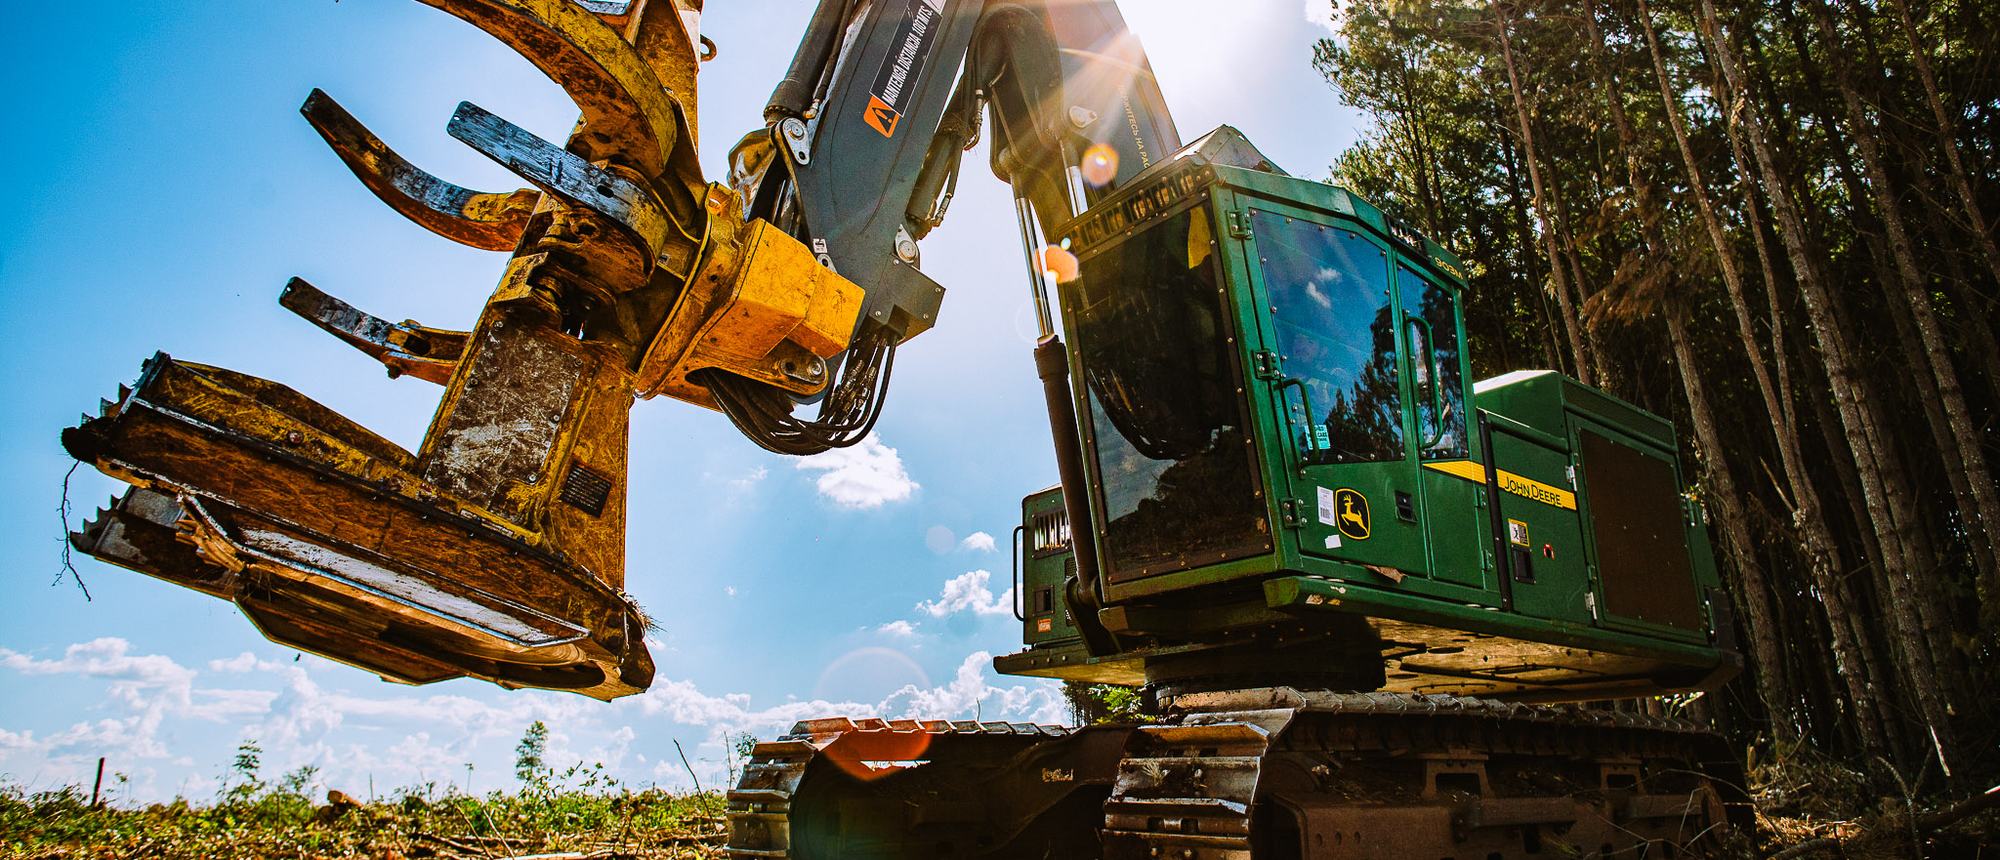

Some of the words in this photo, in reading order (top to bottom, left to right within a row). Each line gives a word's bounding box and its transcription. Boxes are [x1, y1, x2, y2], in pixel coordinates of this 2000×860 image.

[881, 65, 909, 107] MANTENGA
[897, 32, 922, 71] DISTANCIA
[1504, 476, 1531, 497] JOHN
[1531, 484, 1561, 506] DEERE
